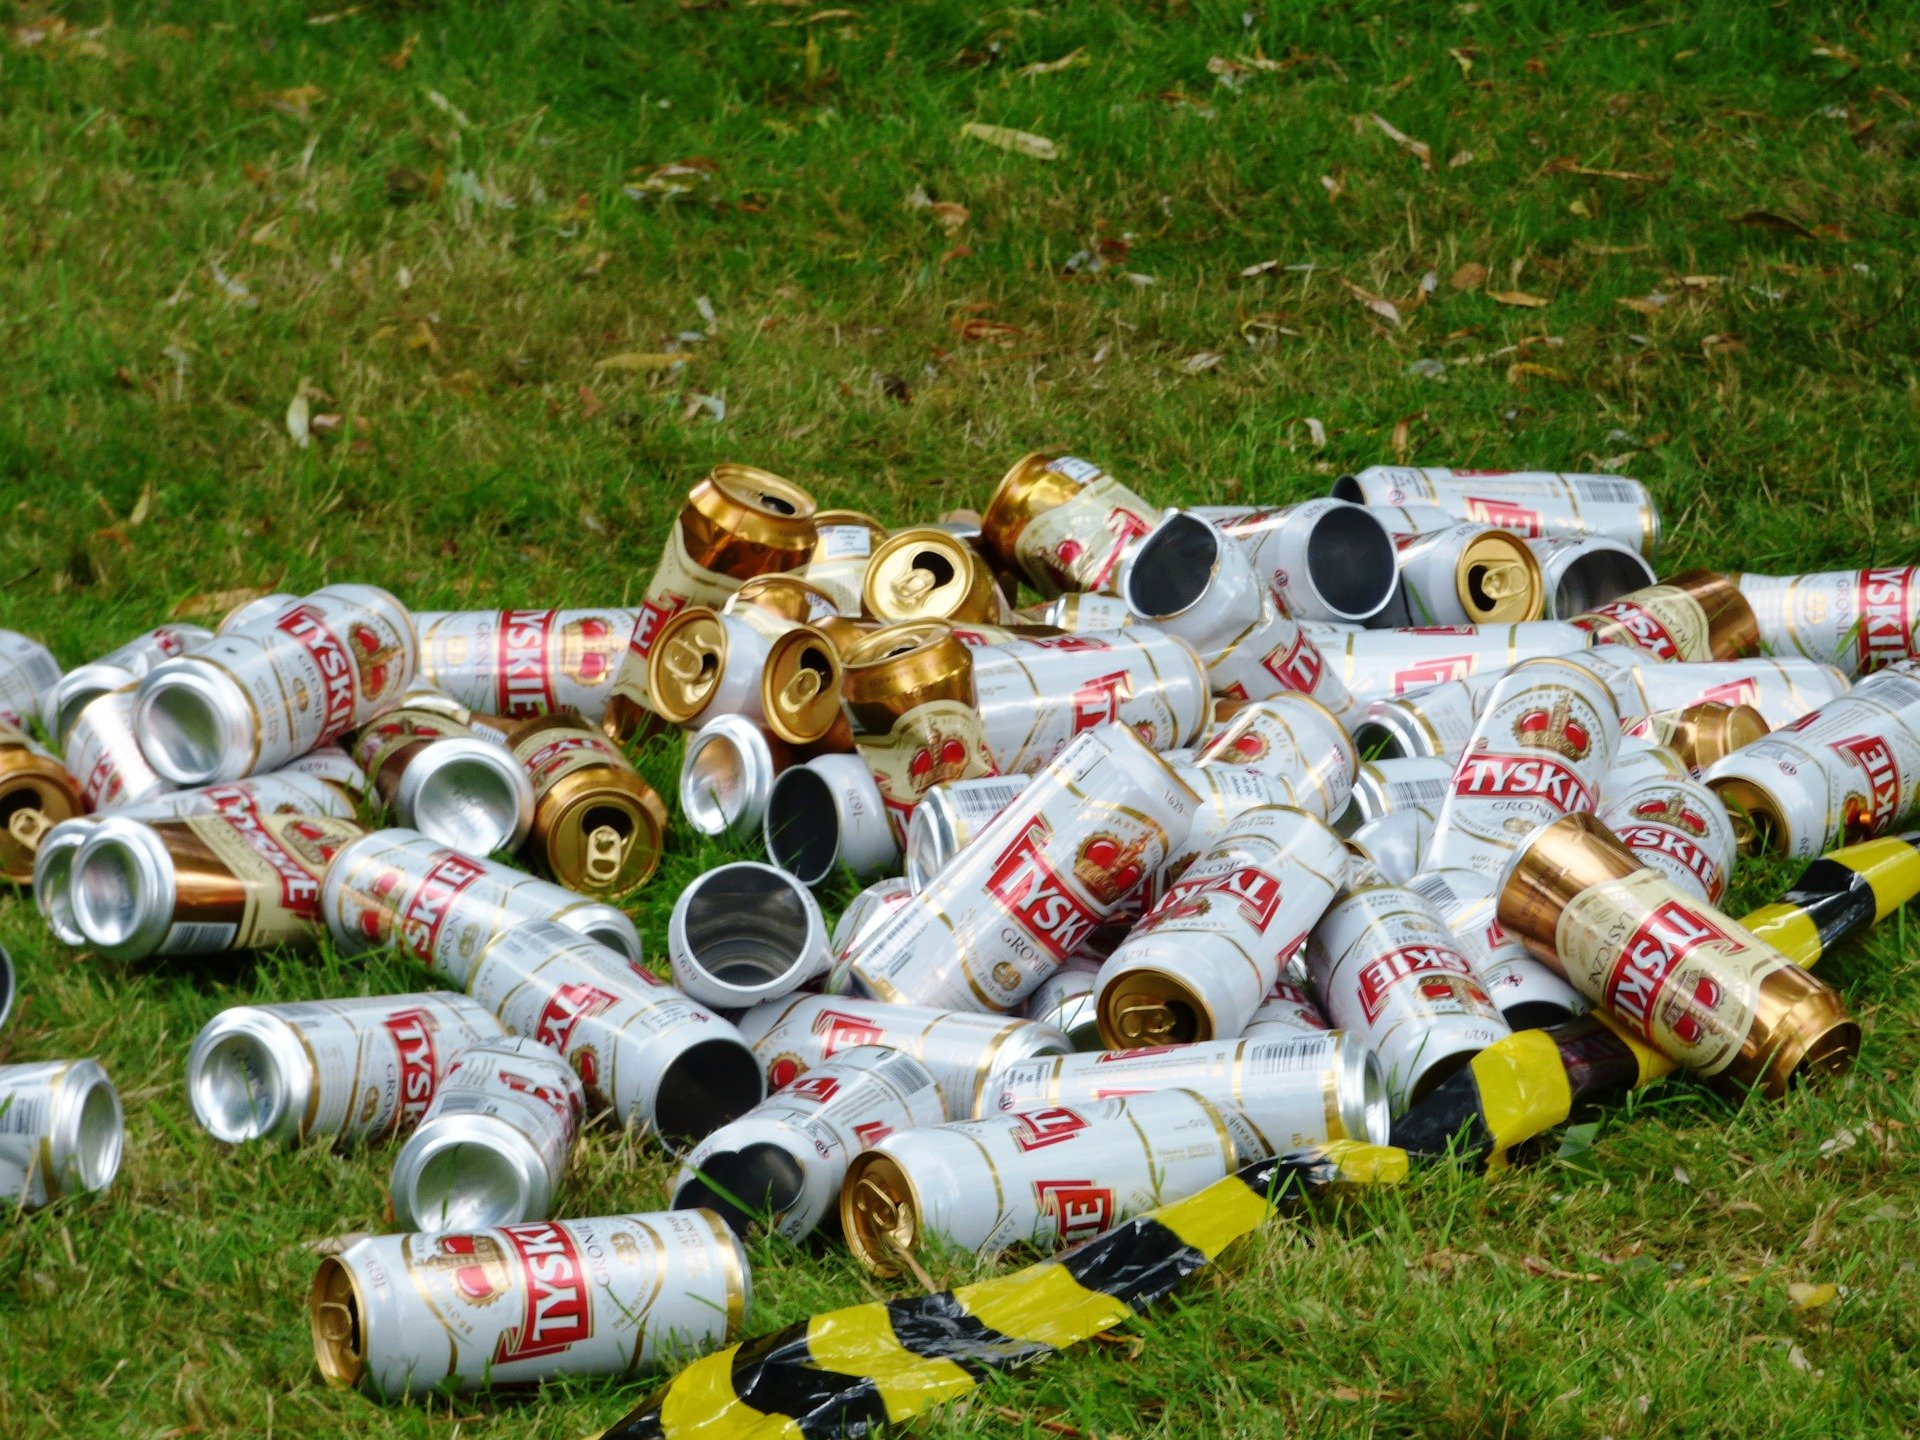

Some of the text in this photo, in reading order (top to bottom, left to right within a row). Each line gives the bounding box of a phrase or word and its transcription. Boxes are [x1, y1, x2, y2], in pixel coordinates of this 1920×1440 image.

[291, 614, 352, 736] TYSKI
[508, 610, 549, 717] YSKIE
[1162, 791, 1185, 815] 1629
[1491, 801, 1555, 823] GRONI
[1001, 848, 1094, 951] TYSK
[1616, 828, 1713, 884] YSKI
[404, 860, 476, 954] SKIE
[1365, 948, 1471, 995] SKIE
[395, 1020, 432, 1125] TYSK
[509, 1223, 579, 1342] TYSKI
